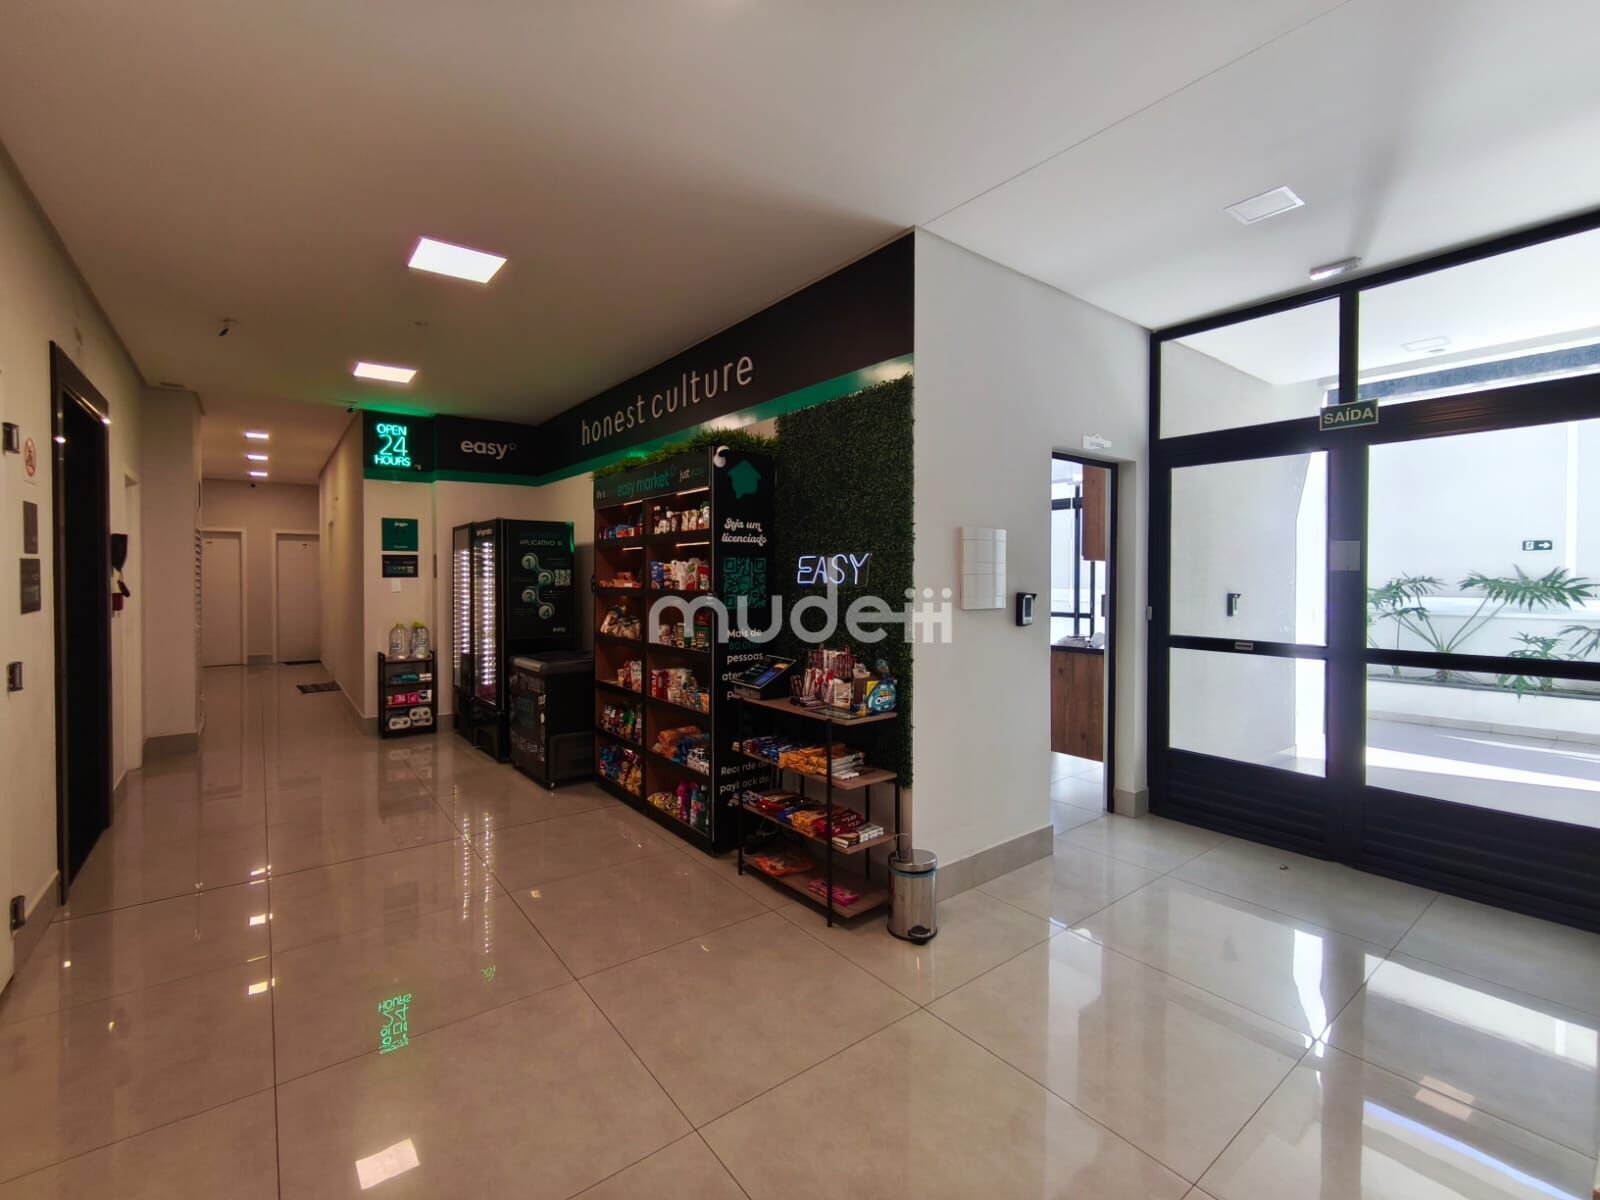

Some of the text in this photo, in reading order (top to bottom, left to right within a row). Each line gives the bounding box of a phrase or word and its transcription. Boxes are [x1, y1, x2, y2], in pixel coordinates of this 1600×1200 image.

[581, 355, 753, 446] honest culture
[1323, 406, 1374, 424] SAÍDA
[376, 423, 408, 437] OPEN
[378, 435, 409, 457] 24
[374, 454, 411, 468] HOURS
[616, 479, 635, 498] easy
[636, 467, 670, 493] market
[723, 517, 763, 533] Seja um
[721, 532, 768, 547] licenciado
[797, 552, 872, 585] EASY
[727, 628, 749, 639] Mais
[726, 652, 764, 665] pessoas
